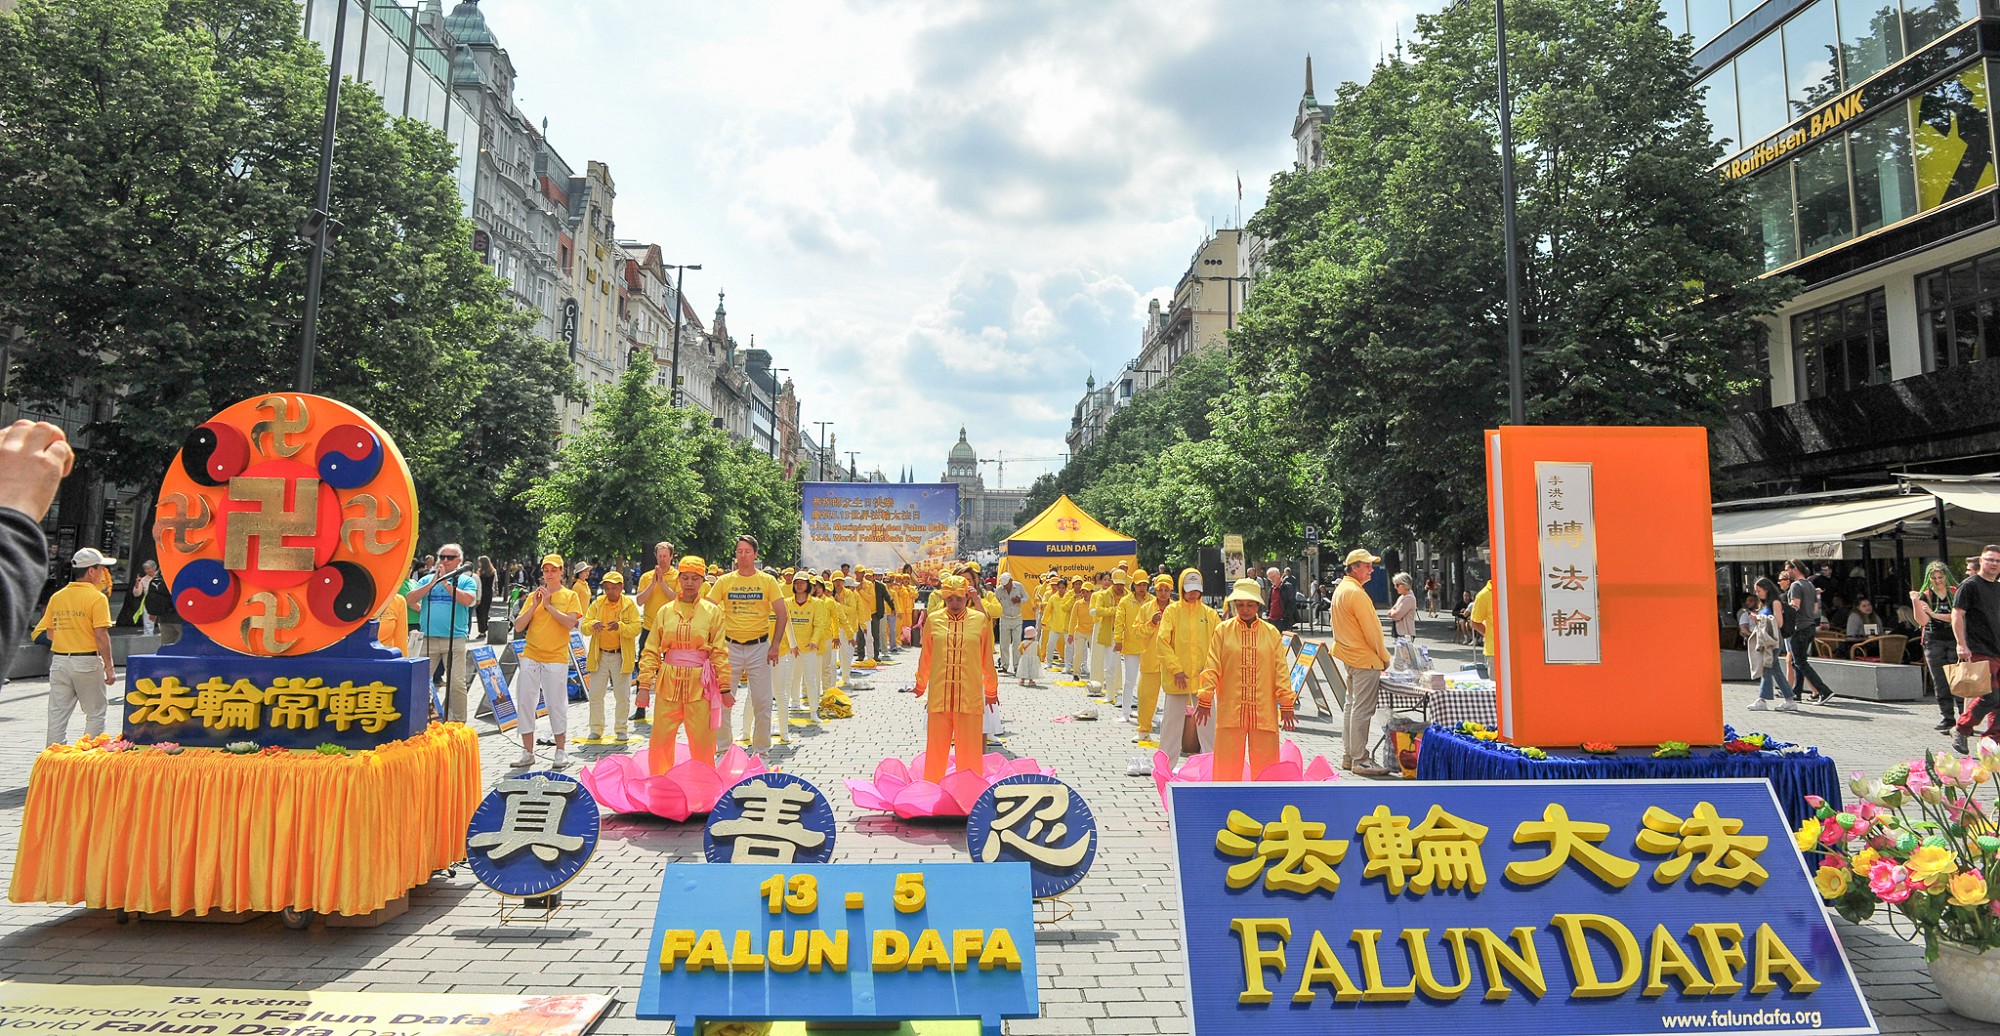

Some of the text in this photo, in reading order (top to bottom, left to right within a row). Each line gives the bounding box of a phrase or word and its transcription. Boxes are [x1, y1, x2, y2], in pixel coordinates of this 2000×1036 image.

[1732, 89, 1865, 179] Raiffeisen BANK
[1548, 475, 1564, 511] 李洪志
[833, 534, 857, 542] World
[859, 534, 883, 543] Falun
[905, 534, 922, 544] Day
[903, 523, 926, 531] Falun
[928, 522, 948, 531] Dafa
[1306, 526, 1315, 539] P
[1046, 544, 1097, 553] FALUN DAFA
[1064, 563, 1095, 572] potřebuje
[1546, 520, 1591, 637] 轉法輪
[127, 675, 402, 733] 法輪常轉
[468, 777, 584, 862] 真
[710, 778, 826, 864] 善
[980, 783, 1091, 868] 忍
[1214, 801, 1769, 896] 法輪大法
[760, 873, 818, 914] 13
[893, 872, 926, 913] 5
[658, 928, 1022, 973] FALUN DAFA
[1230, 913, 1821, 1003] FALUN DAFA
[169, 996, 313, 1007] 13. května
[177, 1008, 245, 1020] den
[255, 1009, 376, 1024] Falun
[388, 1013, 492, 1026] Dafa
[1661, 1008, 1822, 1028] www.falundafa.org
[91, 1020, 219, 1035] Falun
[227, 1023, 334, 1036] Dafa
